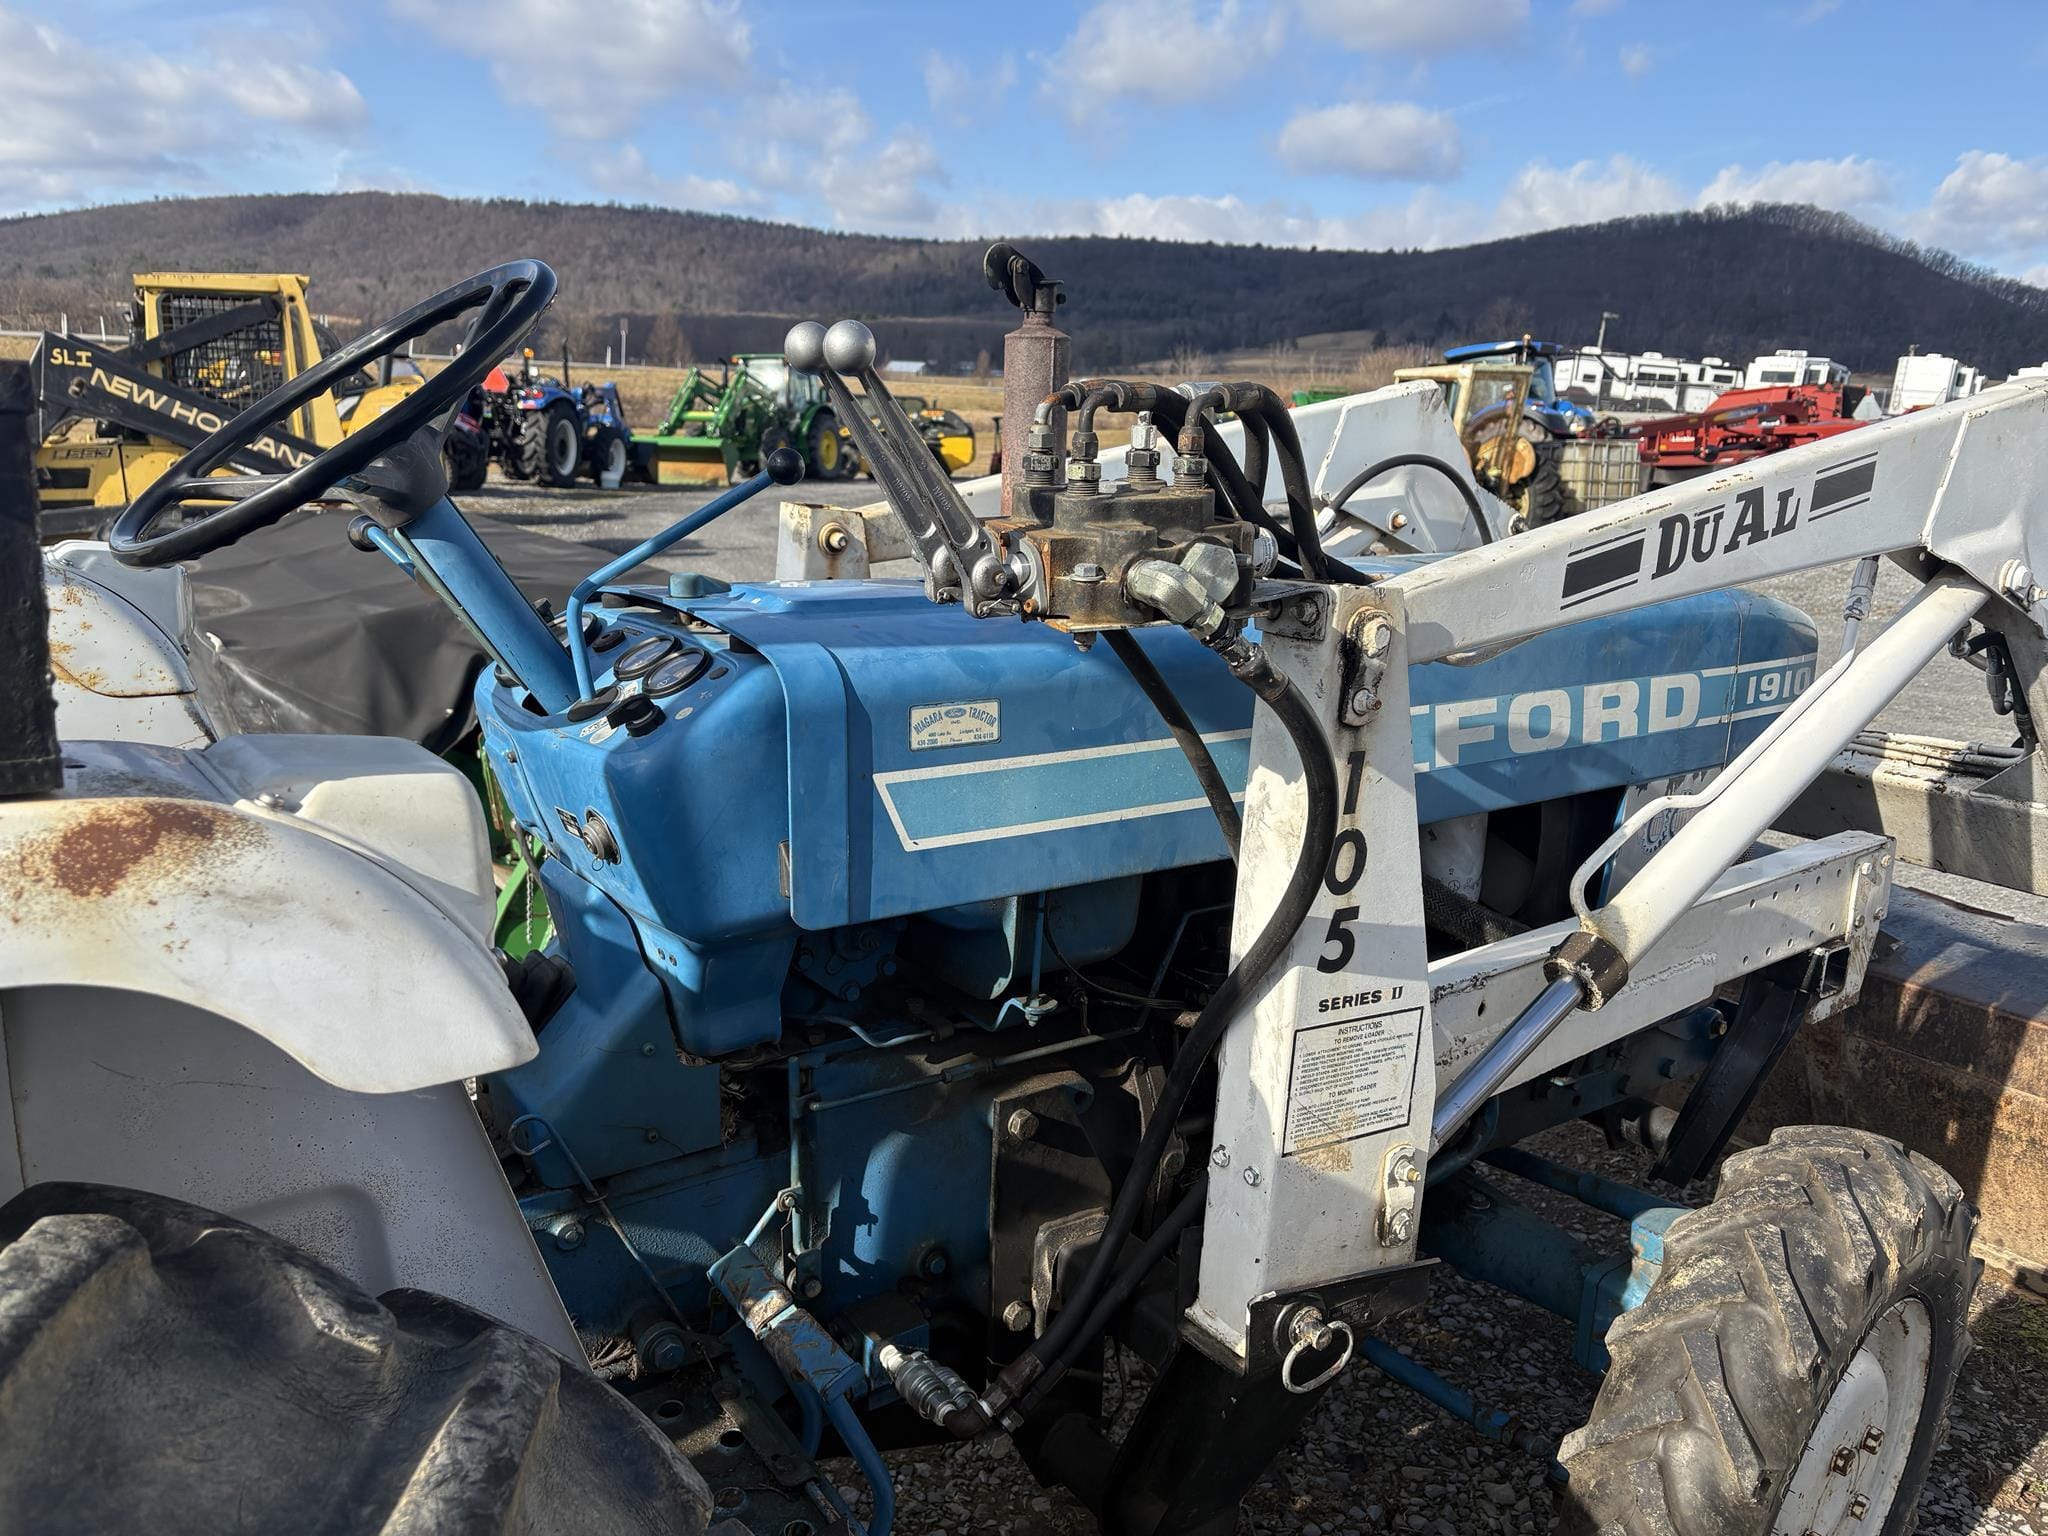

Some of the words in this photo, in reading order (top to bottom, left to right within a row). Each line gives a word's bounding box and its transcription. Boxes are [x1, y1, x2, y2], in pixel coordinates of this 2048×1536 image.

[91, 367, 171, 411] NEW
[1651, 486, 1801, 580] DUAL
[913, 710, 944, 735] NIAGARA
[969, 706, 997, 728] TRACTOR
[1435, 673, 1701, 768] FORD
[1747, 666, 1811, 704] 1910
[1318, 989, 1382, 1013] SERIES
[1338, 1021, 1383, 1036] INSTRUCTIONS
[1343, 1034, 1363, 1043] REMOVE
[1365, 1030, 1385, 1039] LOADER
[1337, 1088, 1355, 1096] MOUNT
[1357, 1083, 1377, 1092] LOADER
